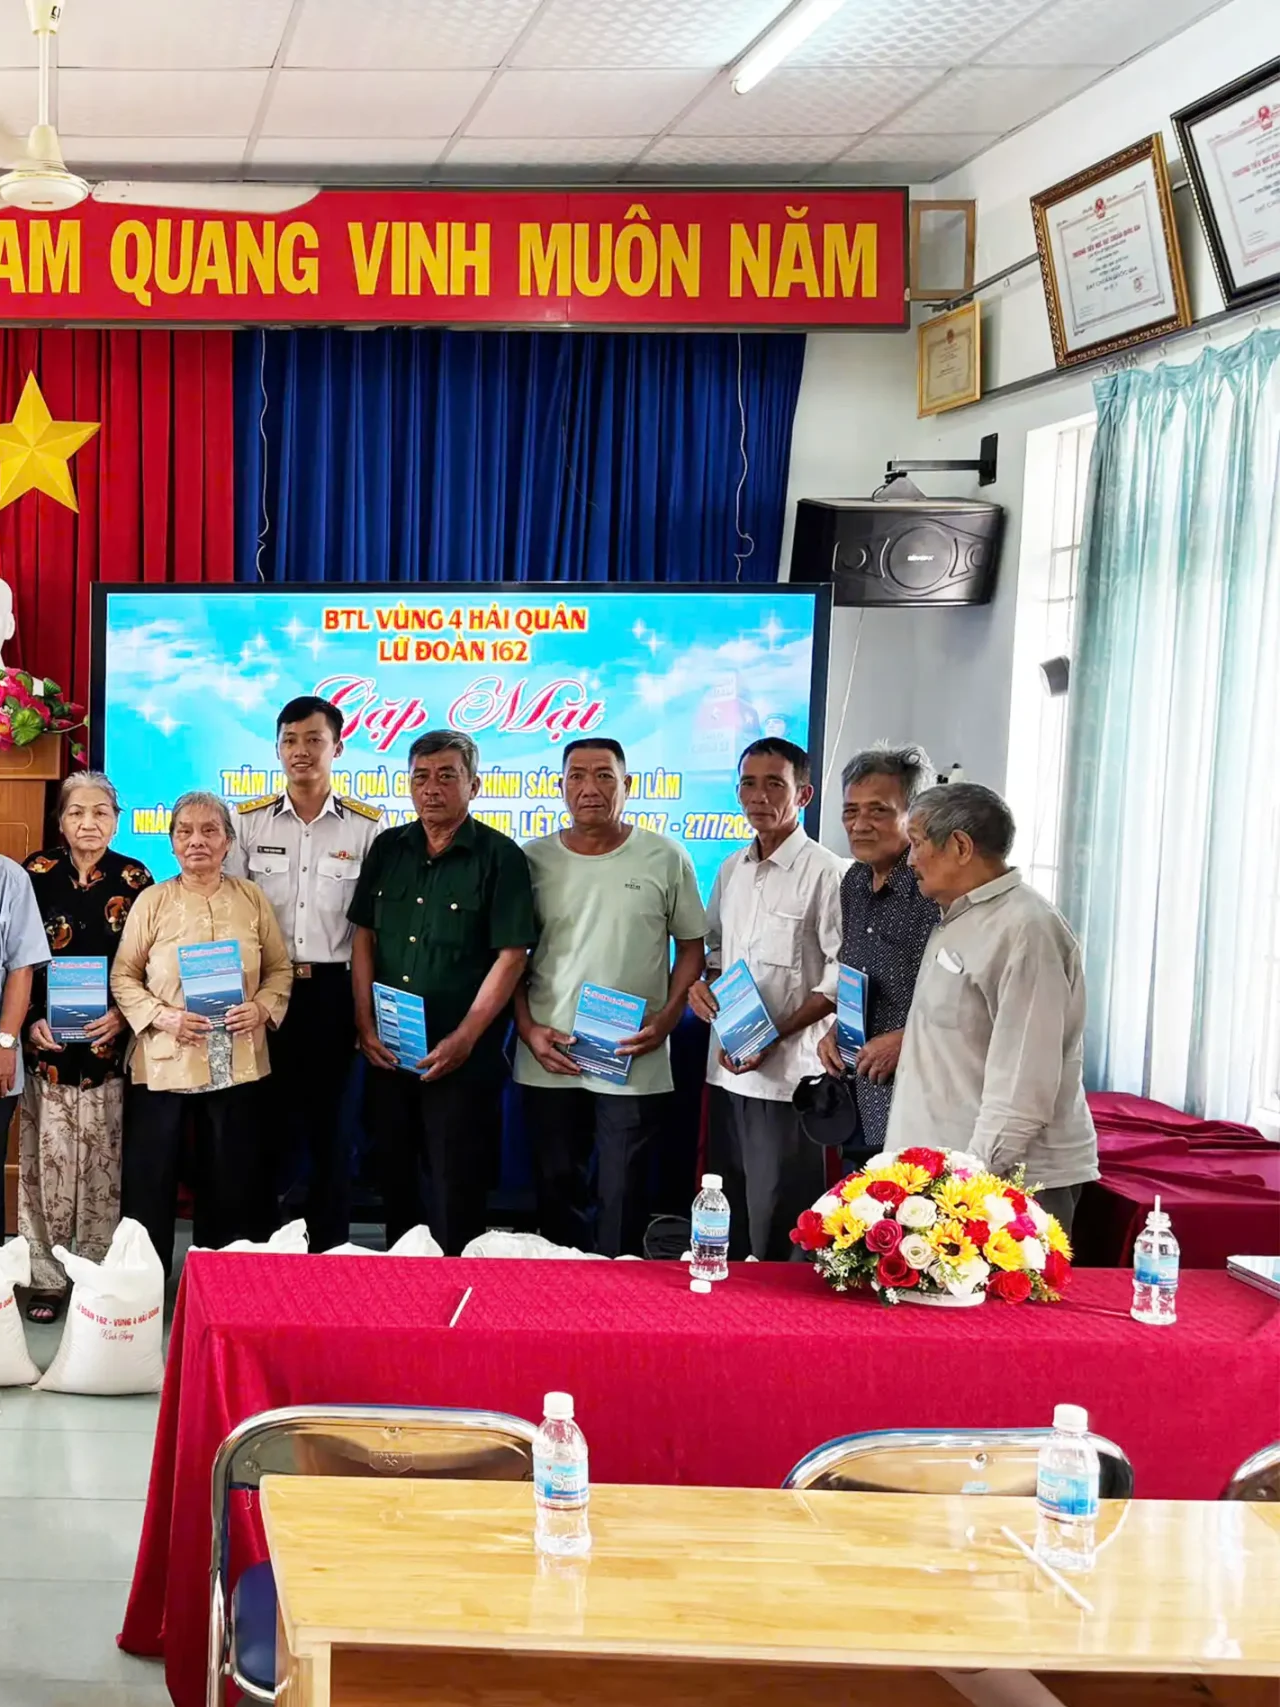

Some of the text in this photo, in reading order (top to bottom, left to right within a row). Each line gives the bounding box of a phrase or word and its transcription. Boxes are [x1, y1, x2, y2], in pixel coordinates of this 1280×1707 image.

[109, 219, 320, 307] QUANG
[348, 222, 490, 296] VINH
[519, 203, 701, 297] MUÔN
[729, 206, 878, 298] NĂM
[323, 602, 587, 635] BTL VÙNG 4 HẢI QUÂN
[378, 632, 529, 662] LỮ ĐOÀN 162
[313, 674, 604, 752] Gặp Mặt
[221, 765, 268, 797] THĂM
[355, 765, 389, 800] QUÀ
[478, 766, 522, 798] HÍNH
[525, 766, 563, 799] SÁC
[644, 767, 682, 799] LÂM
[683, 811, 754, 840] 27/7/202
